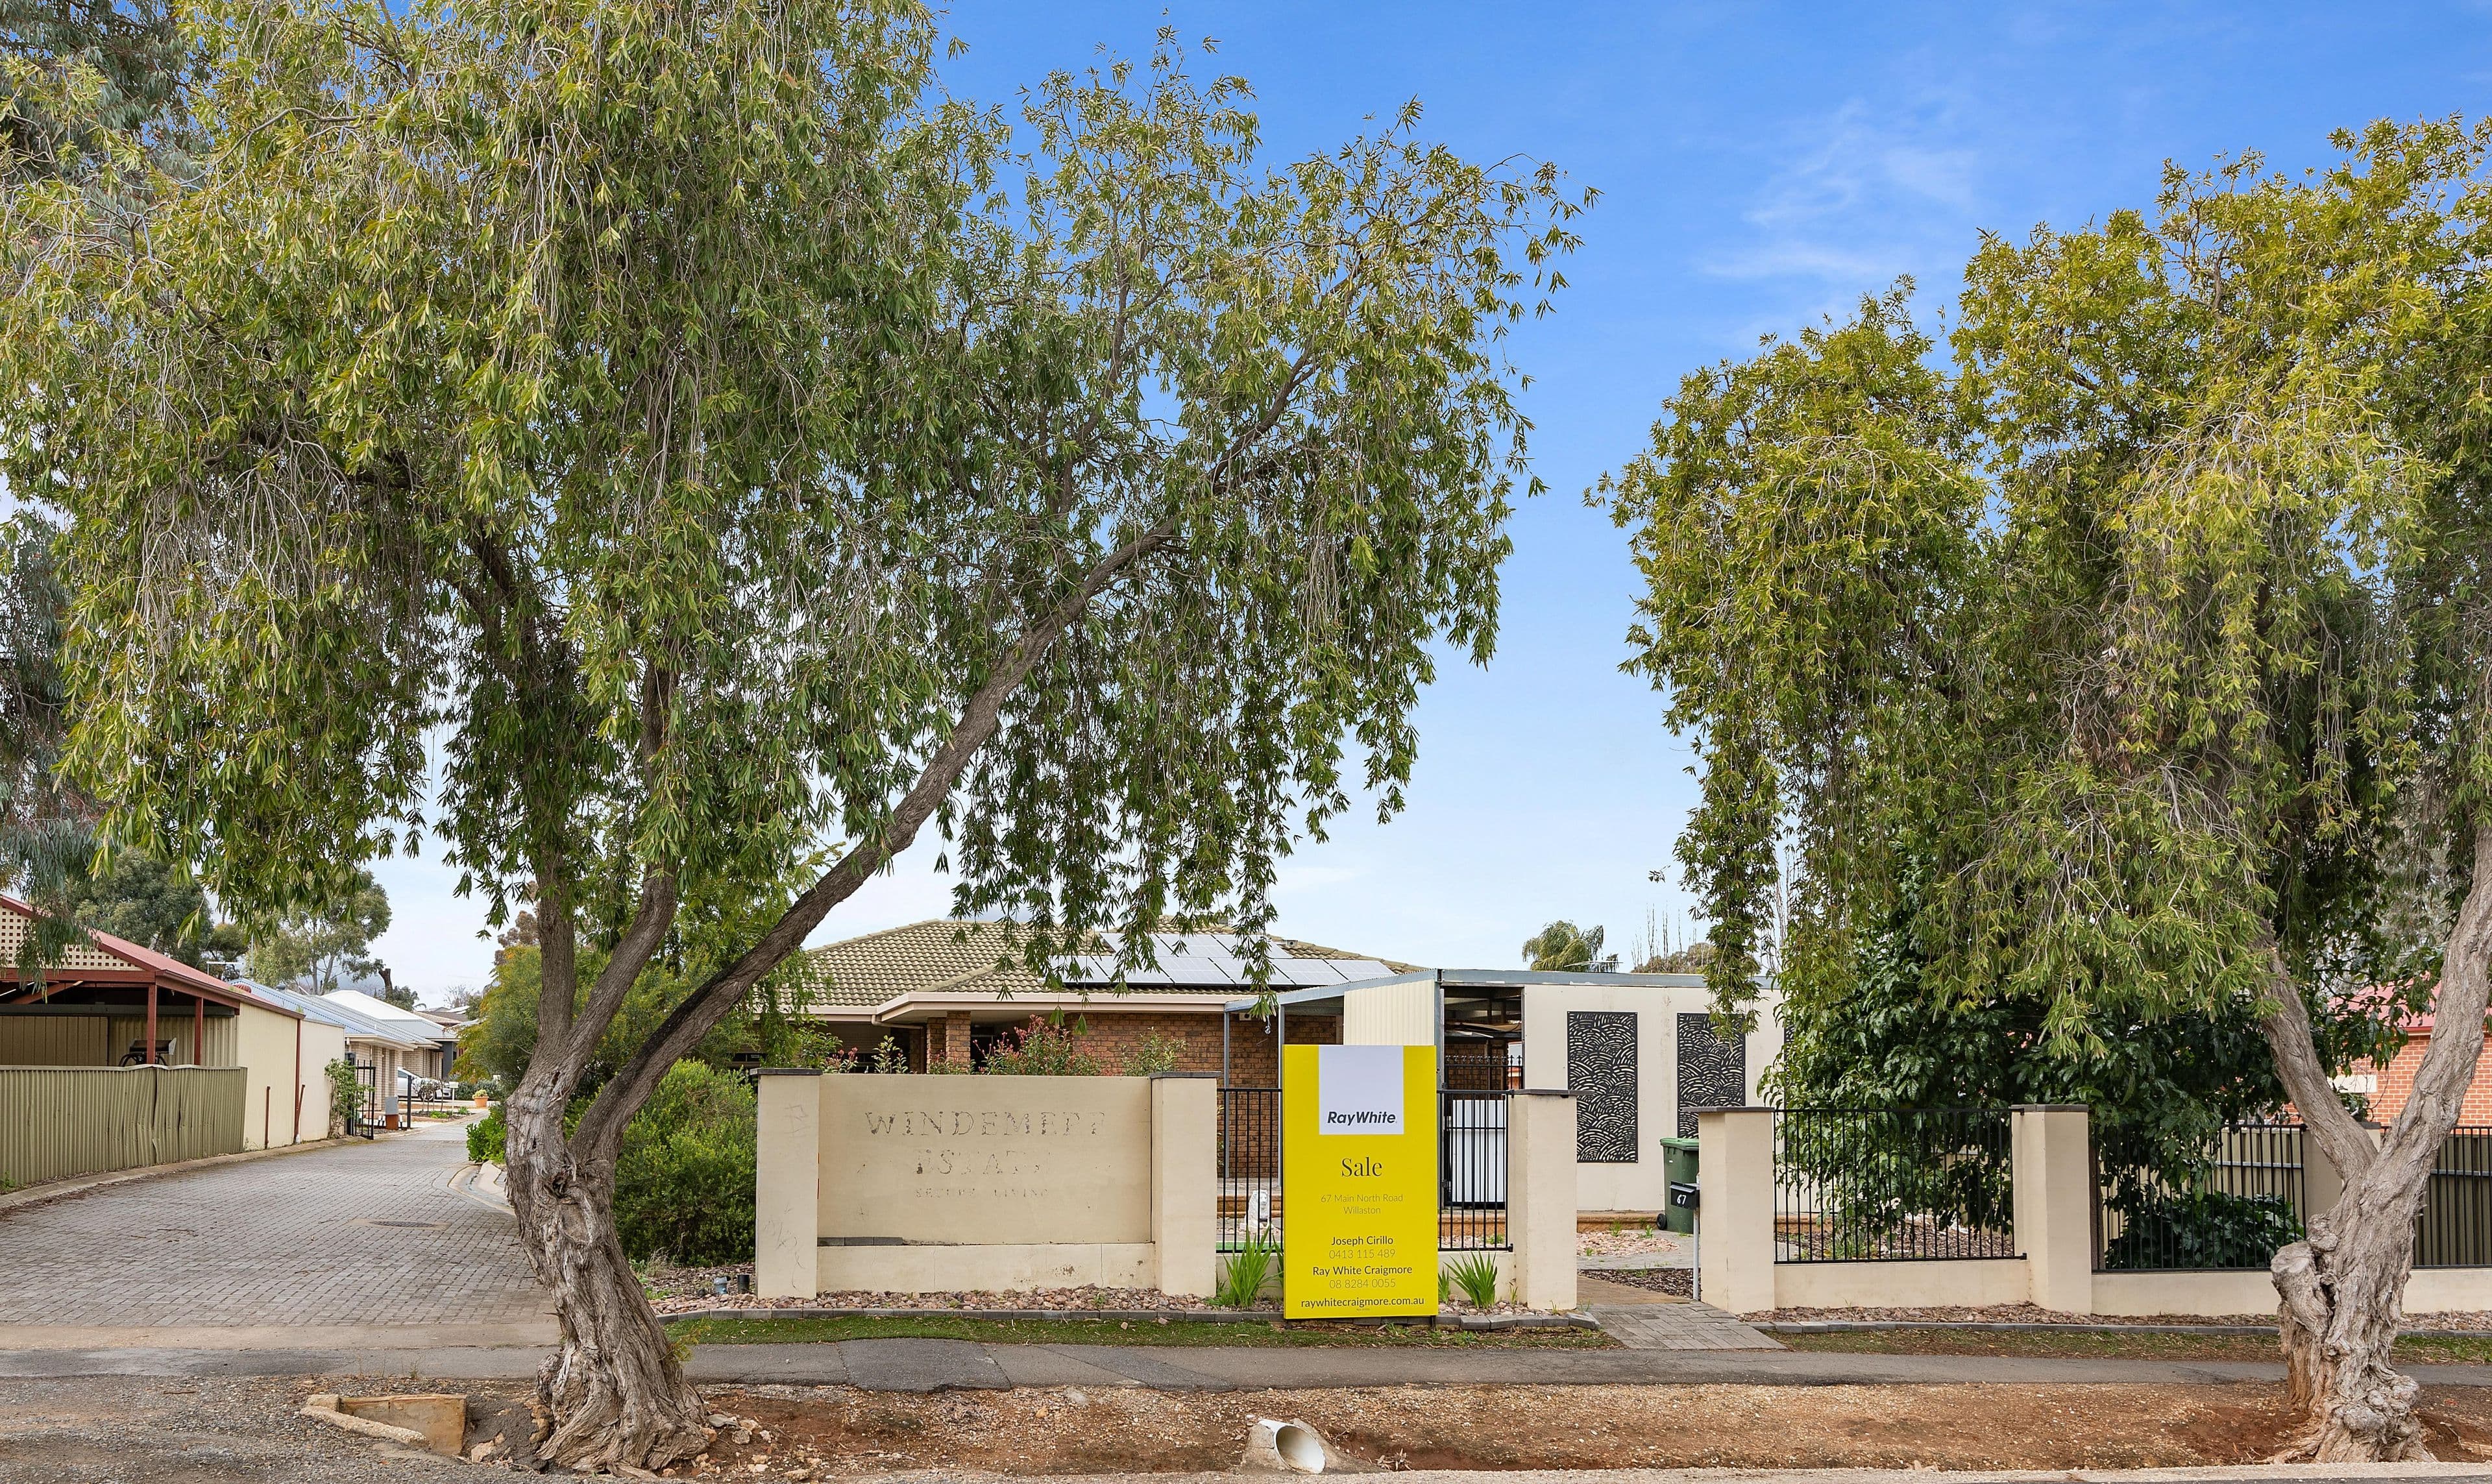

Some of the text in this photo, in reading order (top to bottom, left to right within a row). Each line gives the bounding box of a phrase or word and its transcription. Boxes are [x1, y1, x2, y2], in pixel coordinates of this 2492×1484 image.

[1341, 1156, 1382, 1177] Sale
[1321, 1193, 1403, 1203] 67 Main North Road
[1676, 1194, 1687, 1205] 67
[1331, 1235, 1393, 1247] Joseph Cirillo
[1329, 1248, 1395, 1259] 0413 115 489
[1313, 1265, 1413, 1276] Ray White Craigmore
[1329, 1278, 1396, 1289] 08 8284 0055
[1301, 1297, 1424, 1308] raywhitecraigmore.com.au
